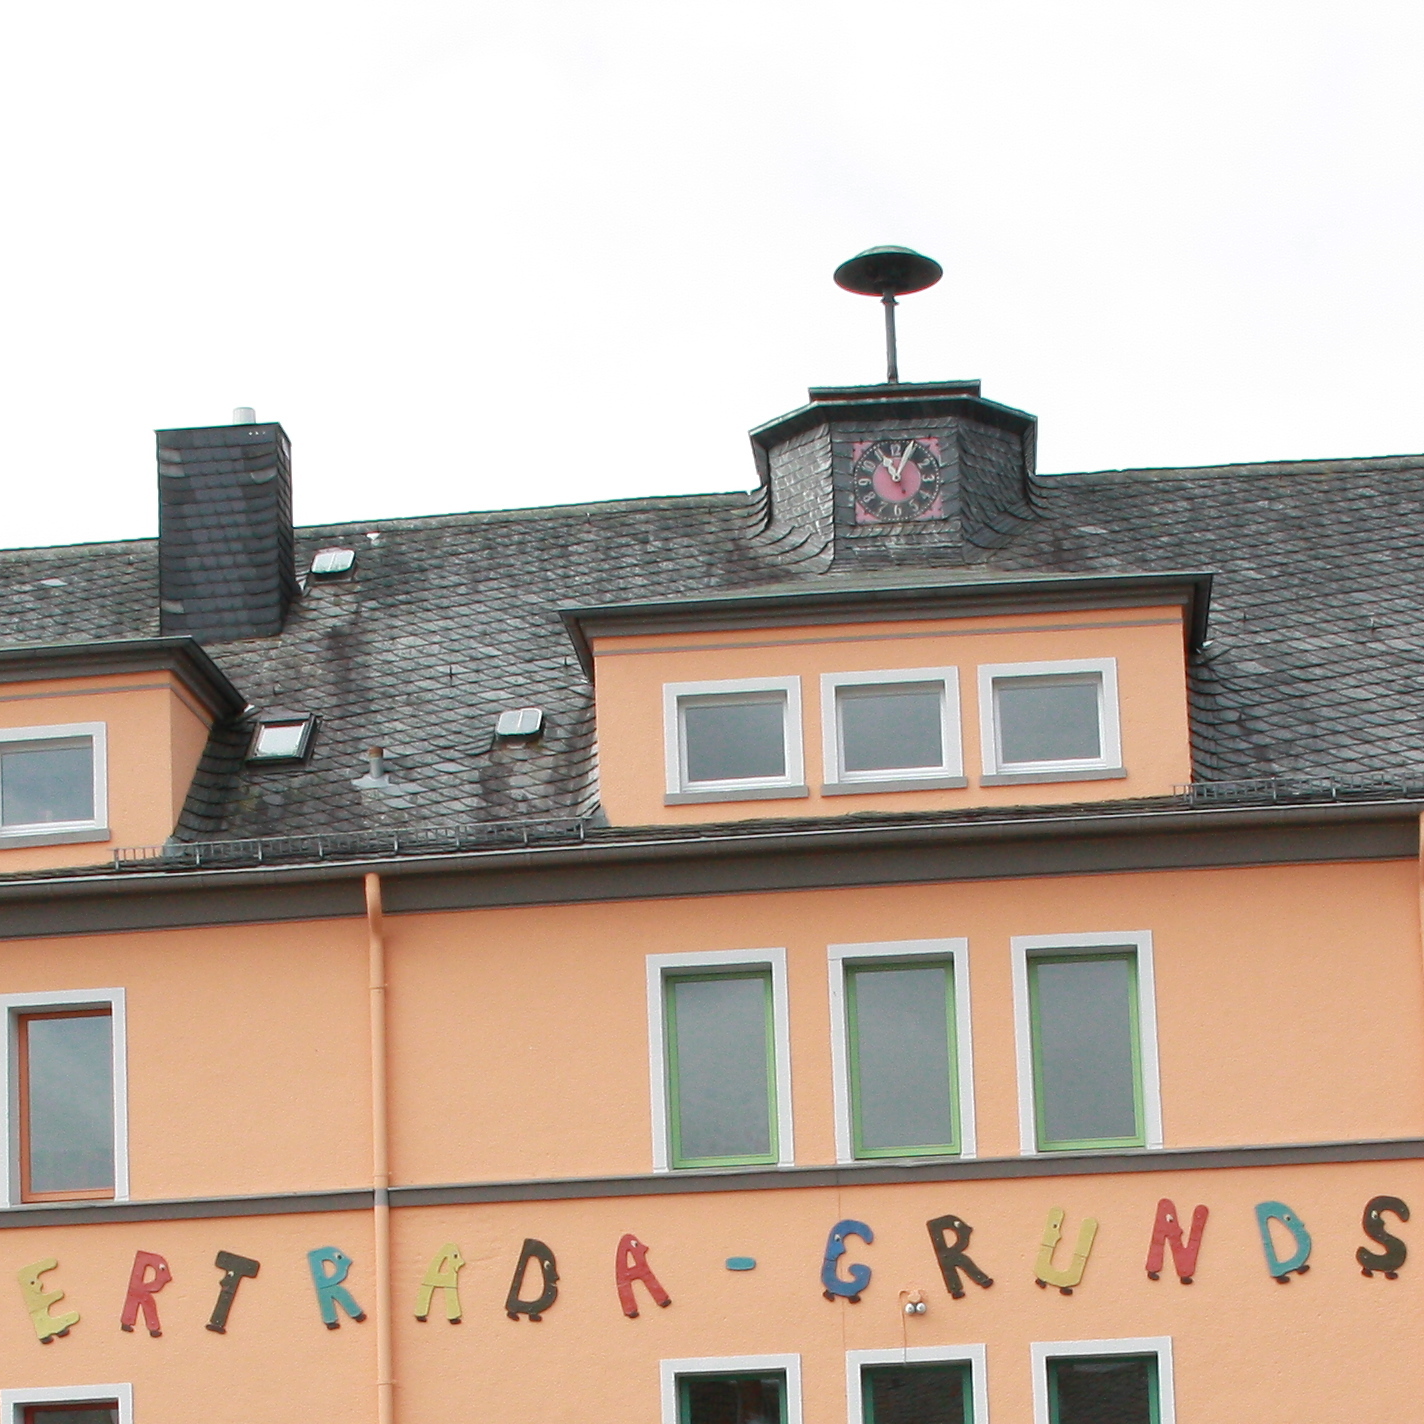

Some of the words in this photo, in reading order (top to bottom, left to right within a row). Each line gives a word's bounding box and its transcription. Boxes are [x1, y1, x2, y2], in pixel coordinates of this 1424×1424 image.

[890, 443, 901, 456] 12
[861, 460, 876, 473] 10
[858, 478, 871, 486] 9
[922, 474, 935, 482] 3
[863, 491, 876, 502] 8
[893, 504, 902, 516] 6
